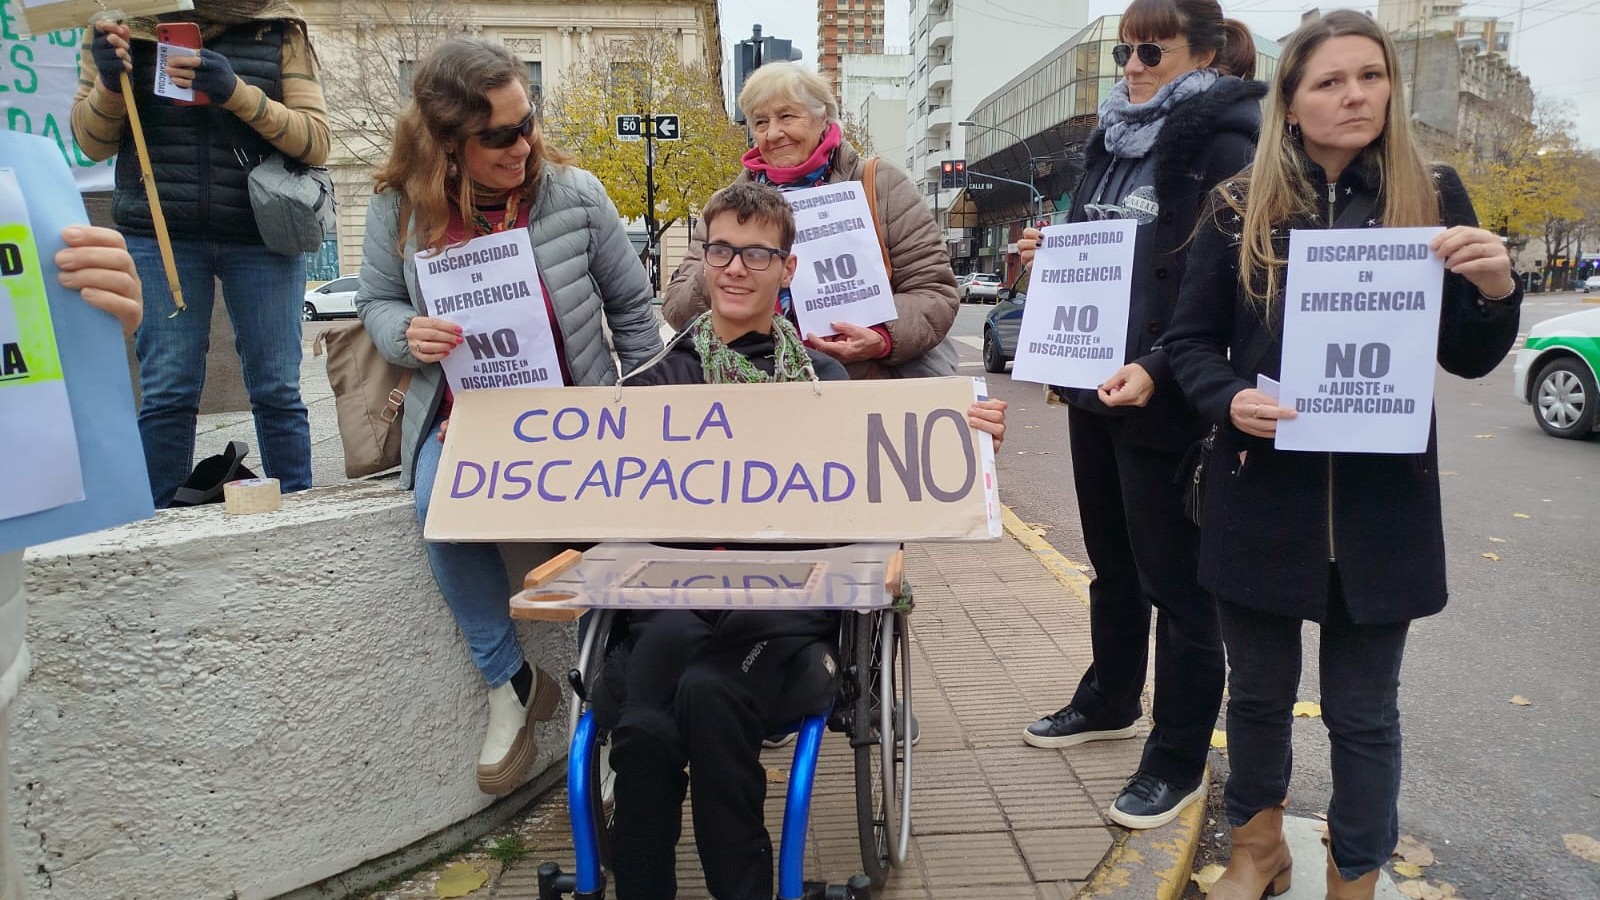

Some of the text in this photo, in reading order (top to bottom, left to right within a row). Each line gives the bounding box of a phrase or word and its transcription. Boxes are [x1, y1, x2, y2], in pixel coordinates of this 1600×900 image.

[622, 121, 636, 131] 50
[795, 217, 866, 243] MERGENCIA
[1047, 231, 1124, 248] DISCAPACIDAD
[428, 243, 519, 275] DISCAPACIDAD
[1078, 252, 1088, 261] EN
[1306, 243, 1429, 263] DISCAPACIDAD
[471, 272, 483, 283] EN
[813, 253, 857, 284] NO
[1041, 266, 1122, 284] EMERGENCIA
[1358, 271, 1373, 282] EN
[434, 280, 530, 316] EMERGENCIA
[805, 284, 881, 312] DISCAPACIDAD
[824, 281, 857, 296] AJUSTE
[1300, 291, 1426, 312] EMERGENCIA
[1052, 305, 1099, 332] NO
[465, 328, 520, 360] NO
[1054, 333, 1092, 345] AJUSTE
[1028, 342, 1114, 360] DISCAPACIDAD
[1324, 342, 1391, 379] NO
[481, 360, 518, 374] AJUSTE
[519, 359, 528, 368] EN
[460, 367, 548, 390] DISCAPACIDAD
[1318, 381, 1394, 396] AL AJUSTE EN
[1295, 397, 1415, 414] DISCAPACIDAD
[513, 402, 733, 442] CON LA
[450, 408, 977, 505] DISCAPACIDAD NO
